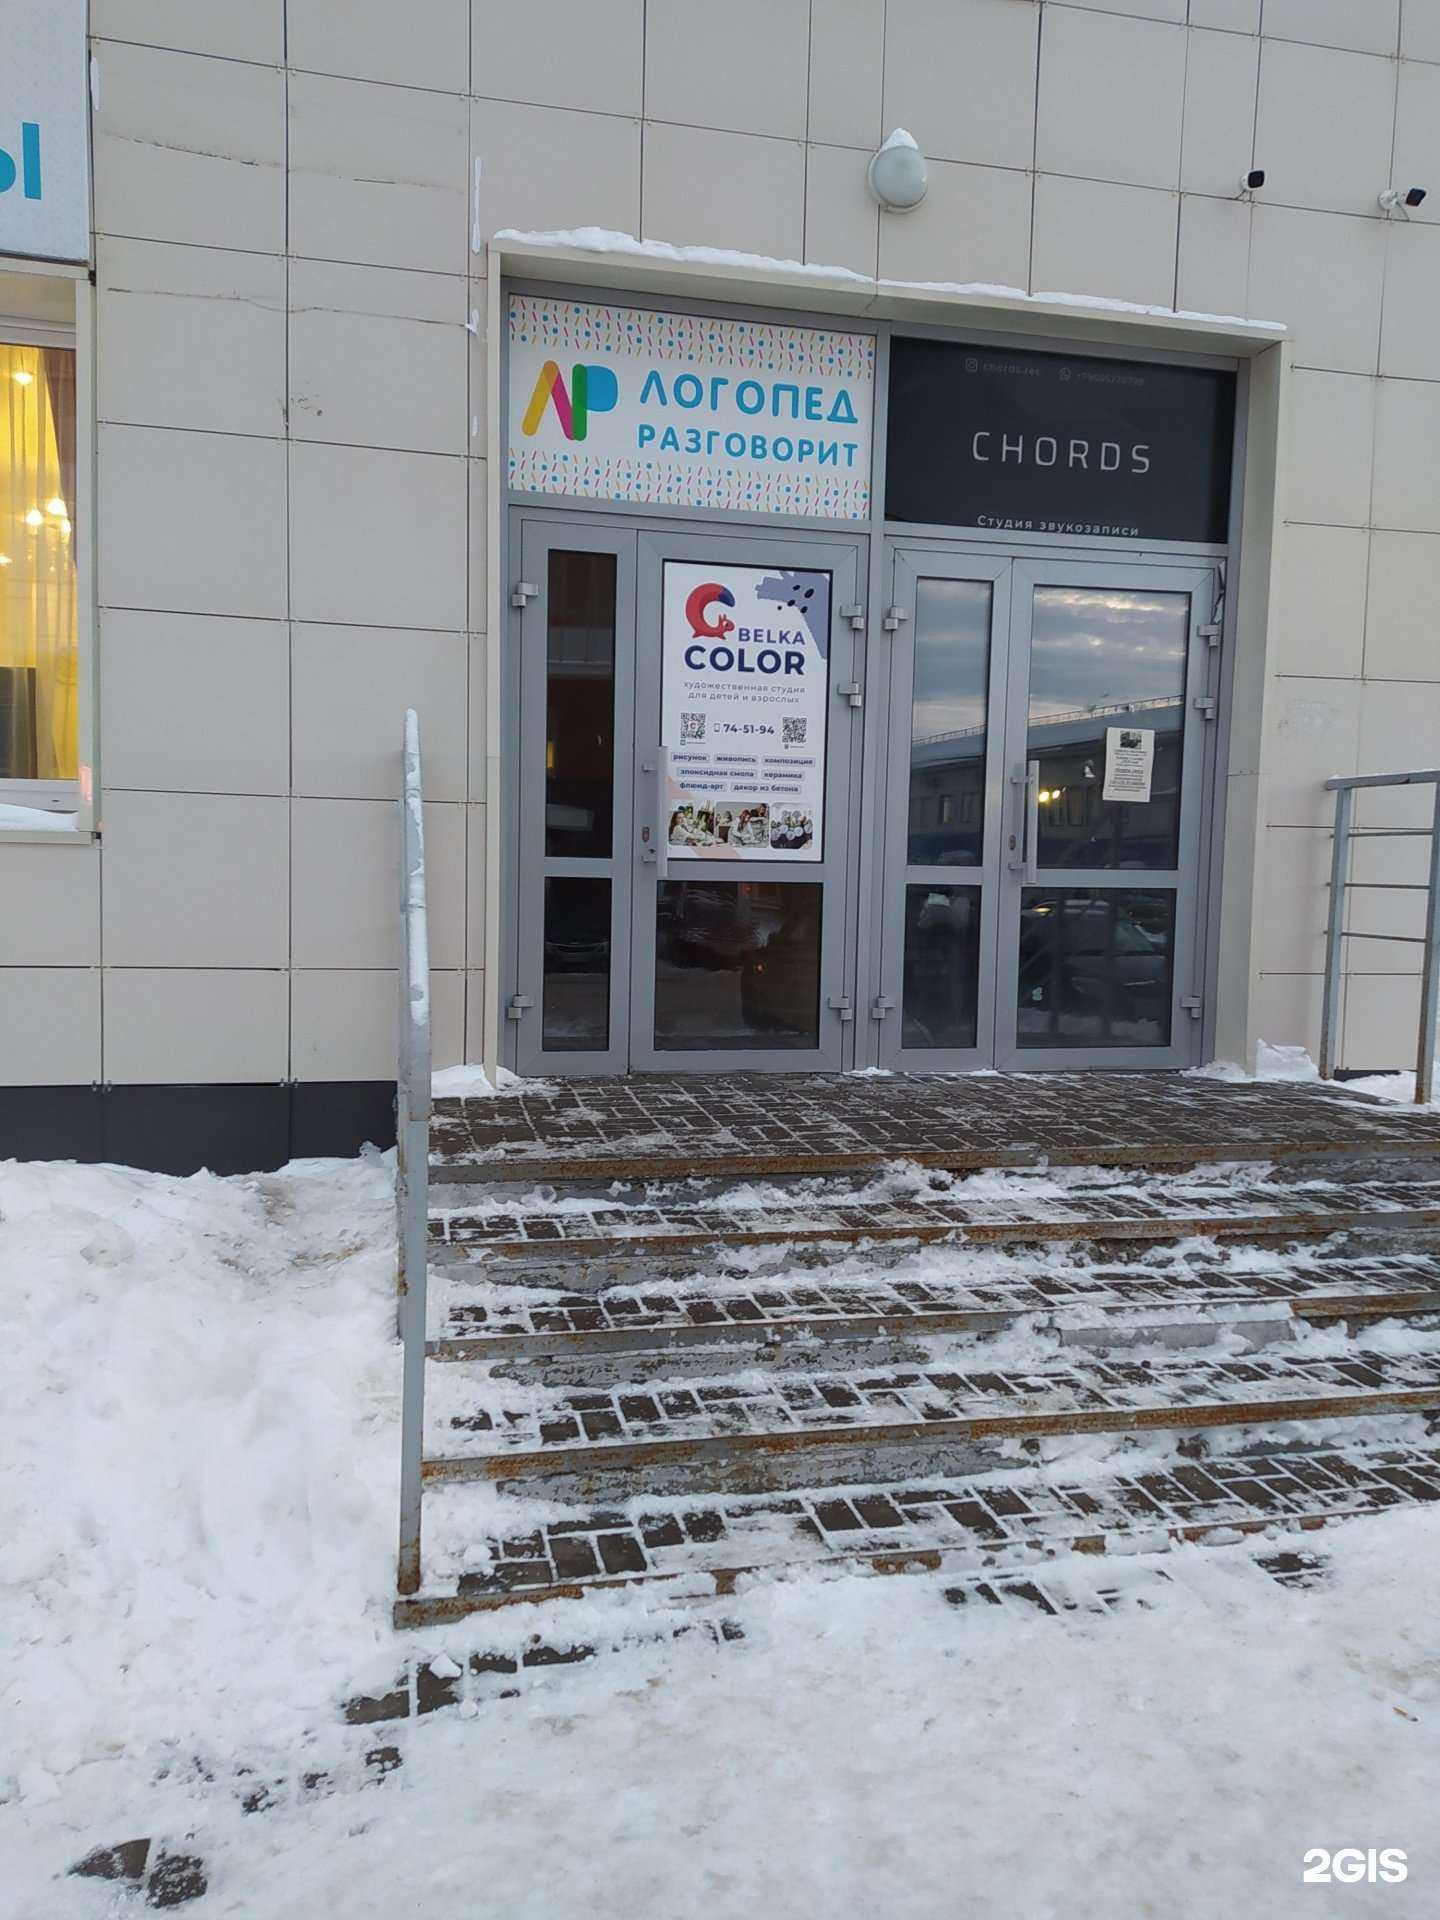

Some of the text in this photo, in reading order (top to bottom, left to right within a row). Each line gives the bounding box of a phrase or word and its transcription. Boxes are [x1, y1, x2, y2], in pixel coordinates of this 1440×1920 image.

[640, 370, 858, 424] ЛОГОПЕД
[638, 424, 858, 467] РАЗГОВОРИТ
[972, 432, 1151, 474] CHORDS
[977, 515, 1139, 537] Студия звукозаписи
[738, 627, 806, 645] BELKA
[684, 645, 806, 676] COLOR
[684, 681, 806, 695] художественная студия
[688, 691, 708, 700] для
[709, 692, 740, 701] детей
[751, 694, 800, 704] взрослых
[723, 723, 775, 735] 74-51-94
[673, 753, 707, 762] рисунок
[716, 755, 757, 763] живопись
[764, 757, 813, 765] композиция
[680, 769, 728, 777] эпоксидная
[764, 772, 803, 780] керамика
[733, 784, 759, 792] декор
[771, 785, 799, 793] бетона
